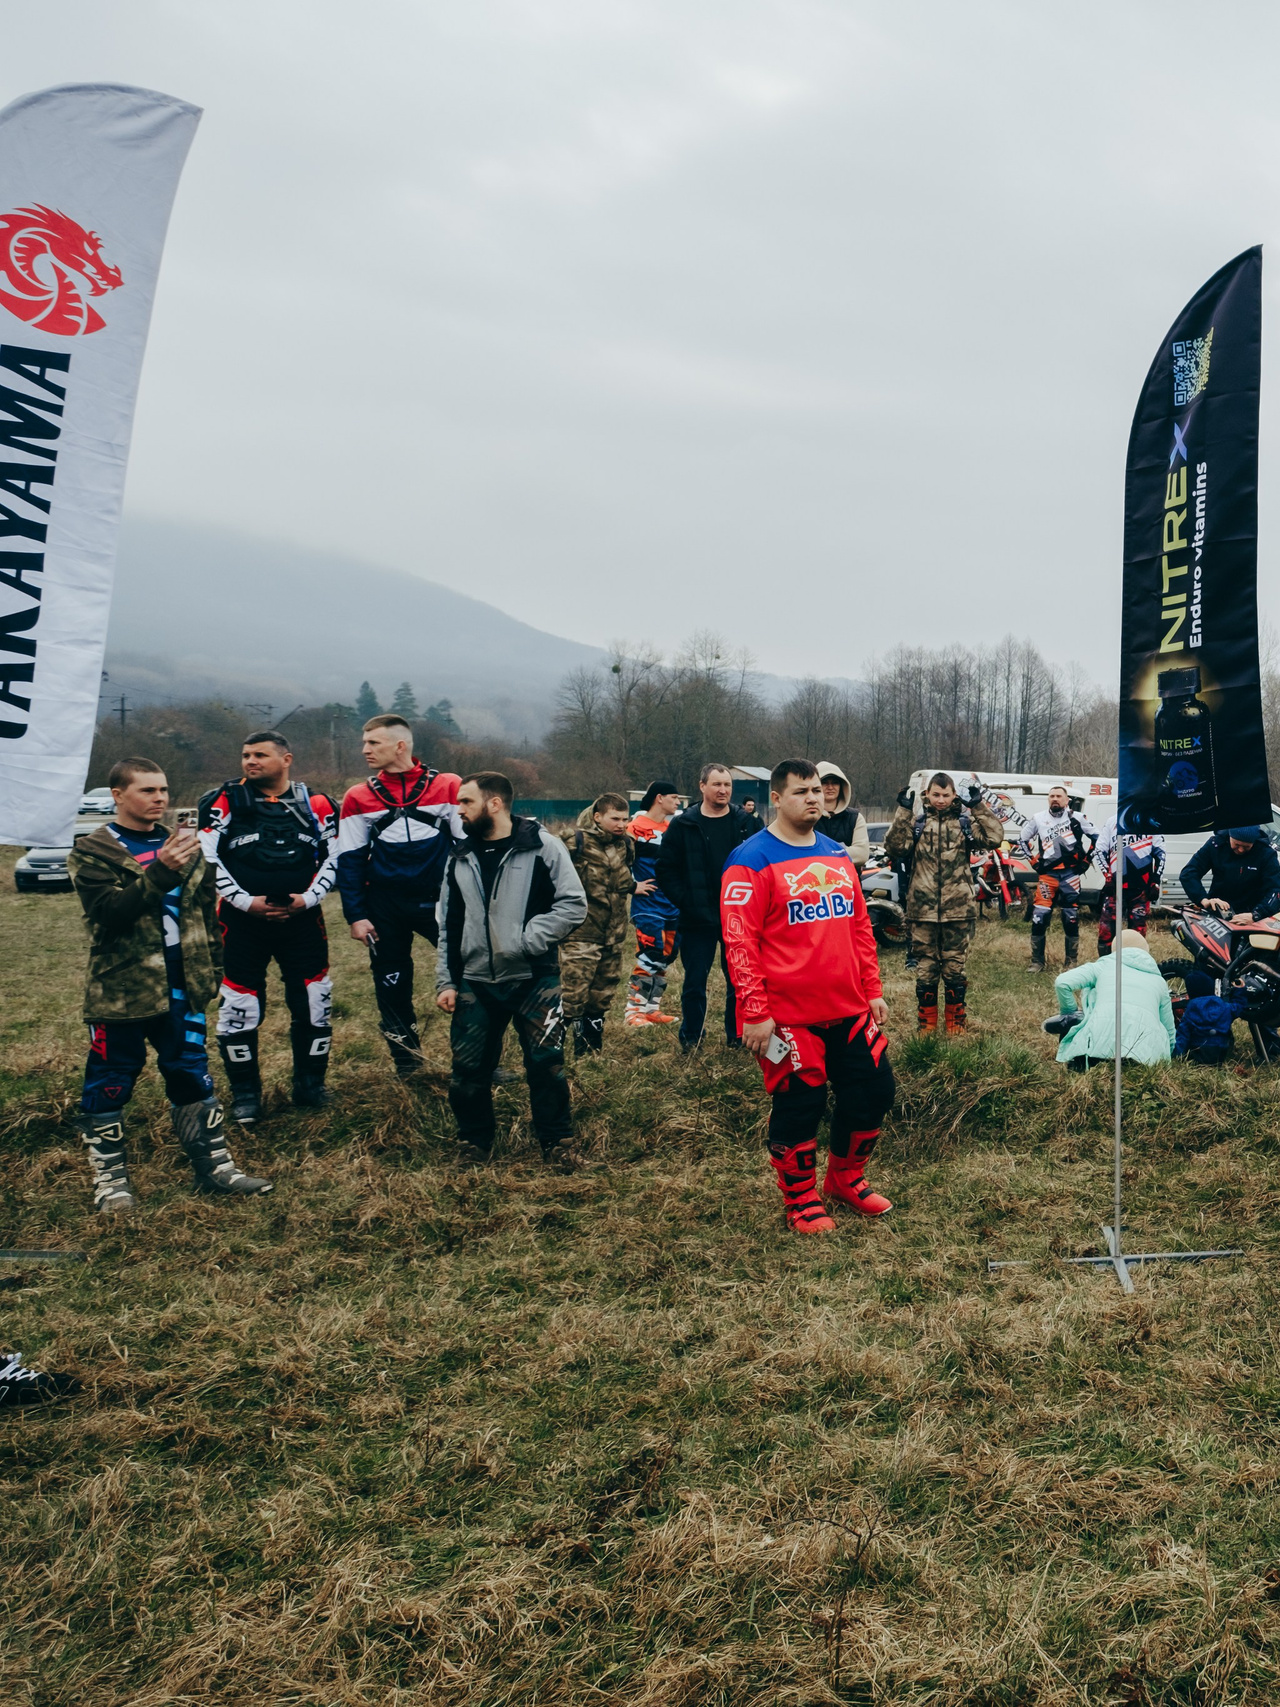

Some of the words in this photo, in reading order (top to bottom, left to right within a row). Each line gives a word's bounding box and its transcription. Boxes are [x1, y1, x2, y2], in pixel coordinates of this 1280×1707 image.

[1194, 461, 1207, 561] vitamins
[1159, 413, 1191, 653] NITREX
[1189, 566, 1202, 648] Enduro
[1160, 736, 1202, 750] NITREX
[1089, 784, 1112, 795] 33
[788, 896, 830, 923] Red
[831, 892, 854, 917] Bu
[1197, 917, 1228, 939] 300
